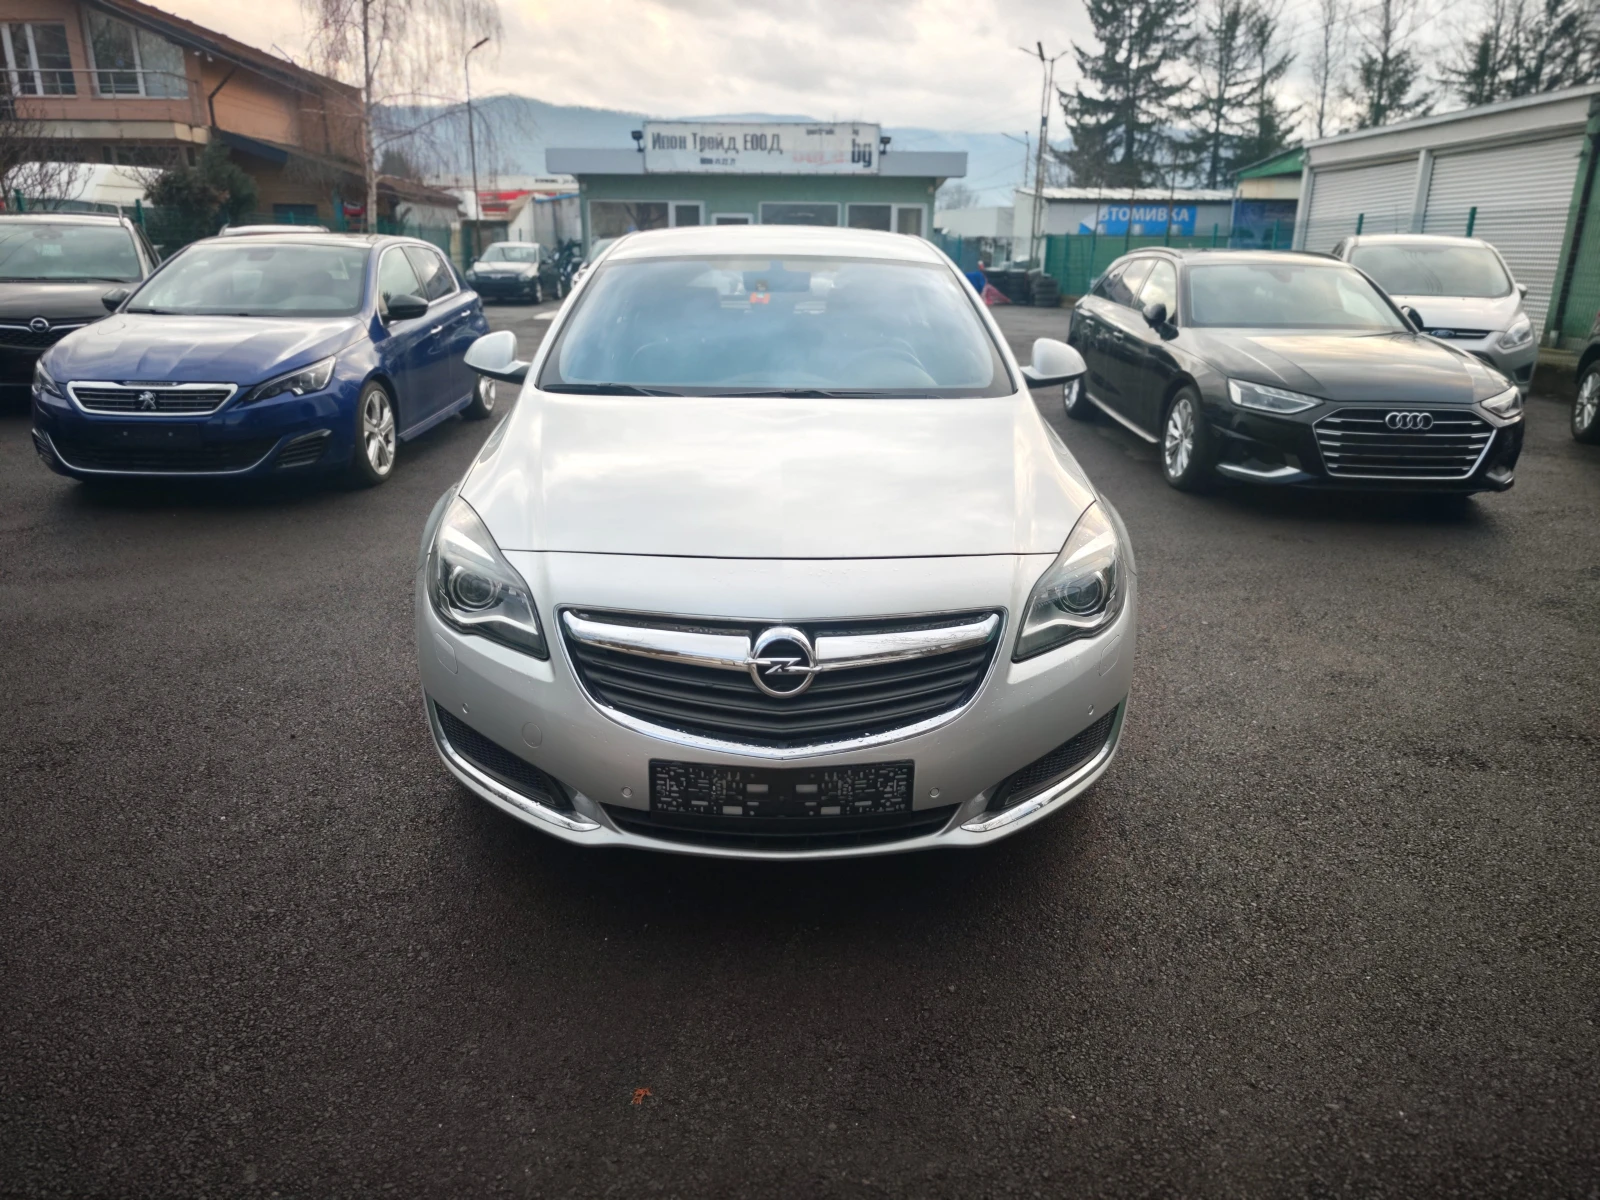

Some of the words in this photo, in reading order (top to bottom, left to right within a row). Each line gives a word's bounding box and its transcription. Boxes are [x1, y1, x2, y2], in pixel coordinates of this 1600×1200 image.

[651, 131, 687, 149] Ипон
[691, 132, 738, 153] Трейд
[743, 133, 783, 154] ЕООД
